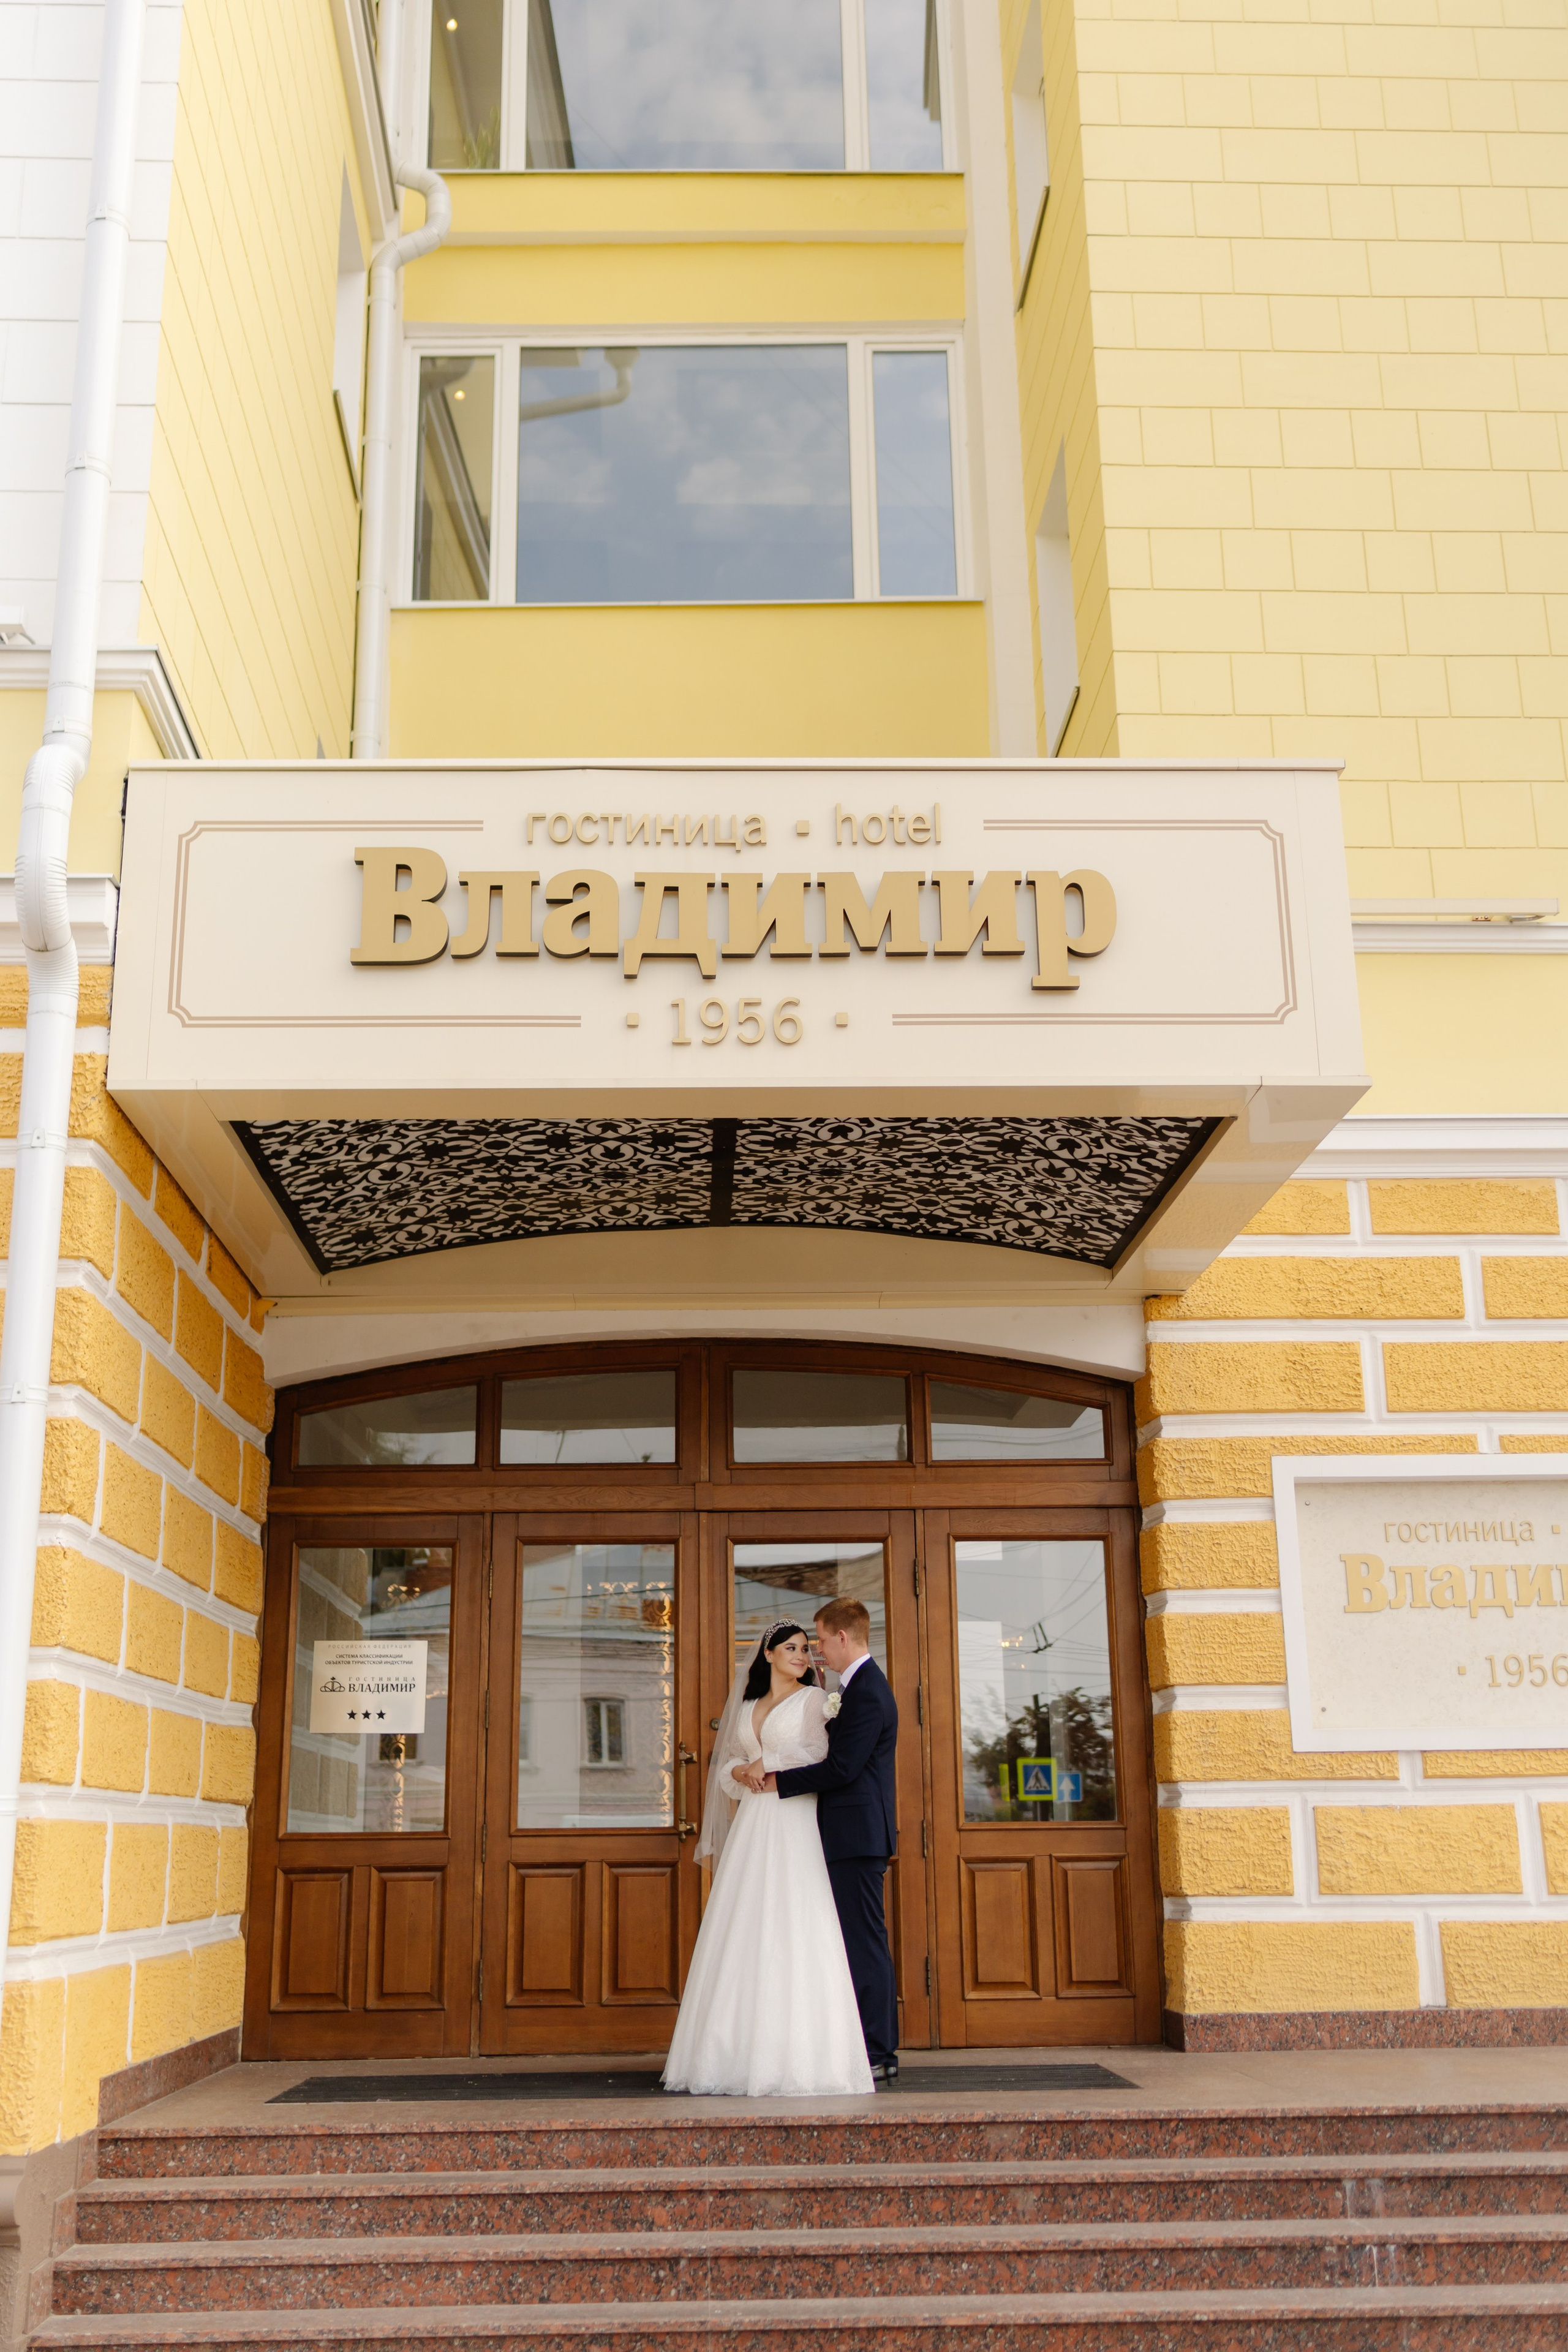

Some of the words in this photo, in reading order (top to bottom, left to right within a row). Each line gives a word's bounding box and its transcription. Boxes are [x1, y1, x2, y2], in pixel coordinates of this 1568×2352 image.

[526, 811, 768, 852] гостиница
[834, 803, 943, 845] hotel
[350, 846, 1117, 991] Владимир
[669, 996, 805, 1046] 1956
[1384, 1520, 1536, 1546] гостиница
[1340, 1553, 1568, 1618] Влади
[349, 1683, 415, 1694] ВЛАДИМИР
[1485, 1653, 1568, 1687] 1956
